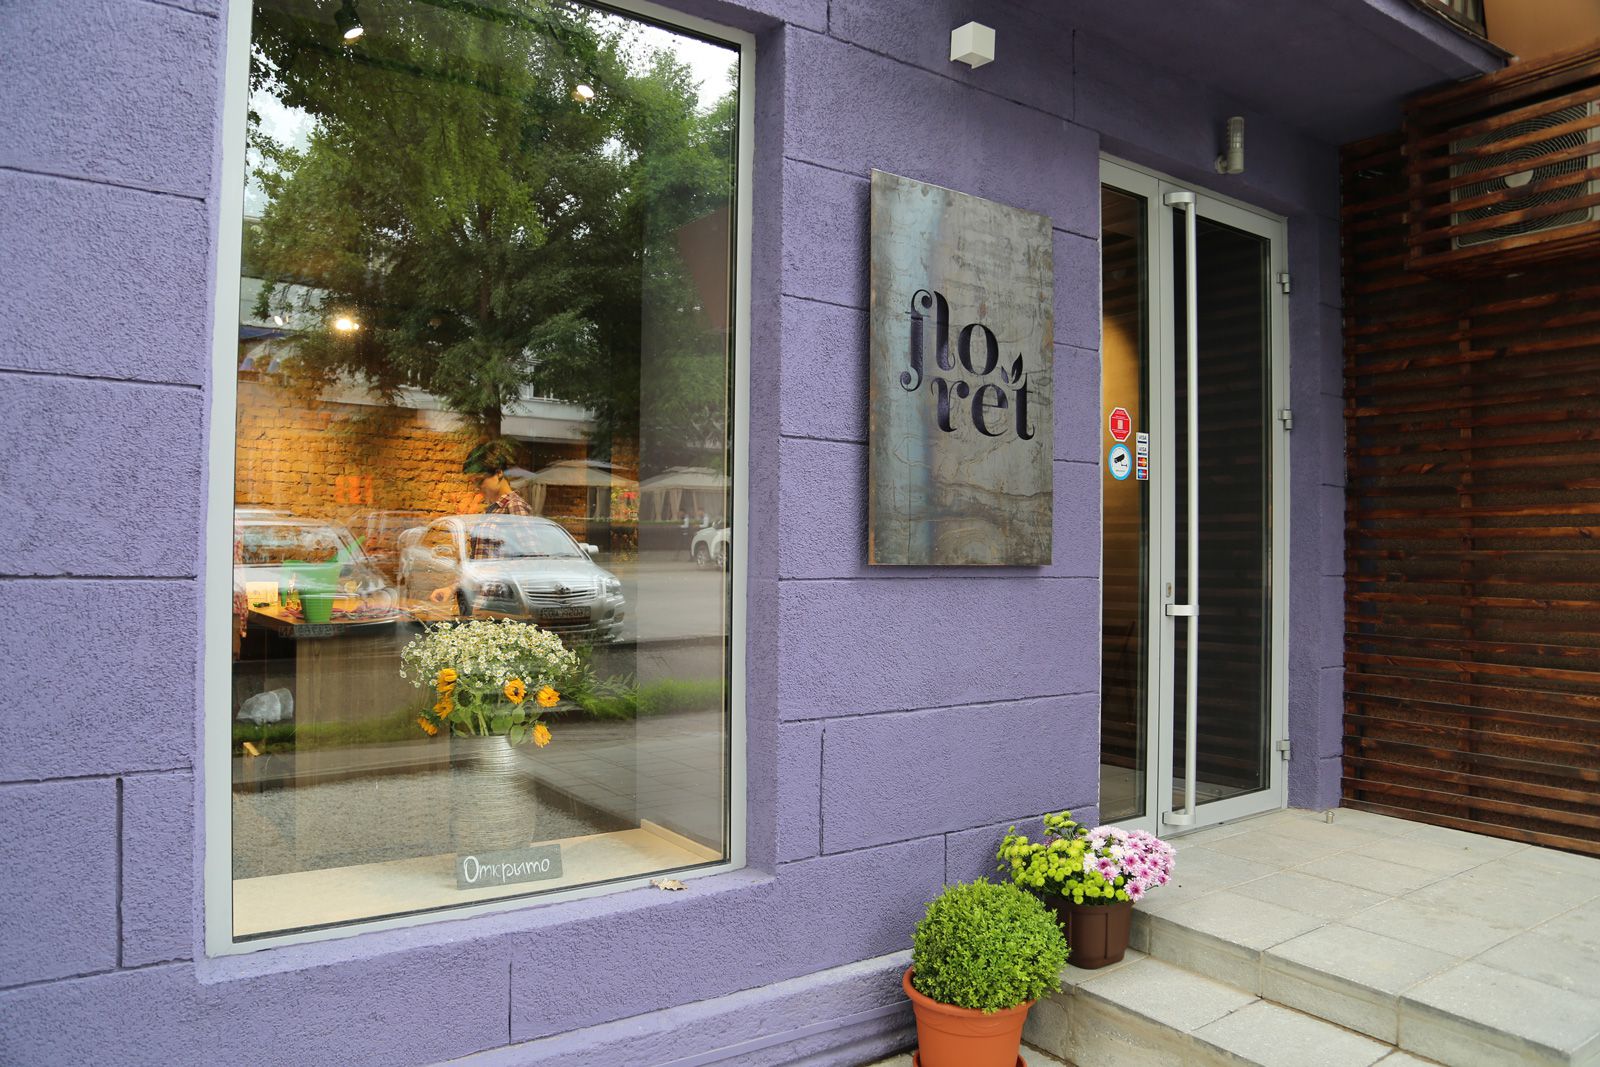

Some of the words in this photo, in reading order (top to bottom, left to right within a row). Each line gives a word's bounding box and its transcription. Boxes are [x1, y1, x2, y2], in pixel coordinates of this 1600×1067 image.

[900, 289, 999, 392] flo
[931, 372, 1035, 440] ret
[463, 855, 550, 883] Открыто
